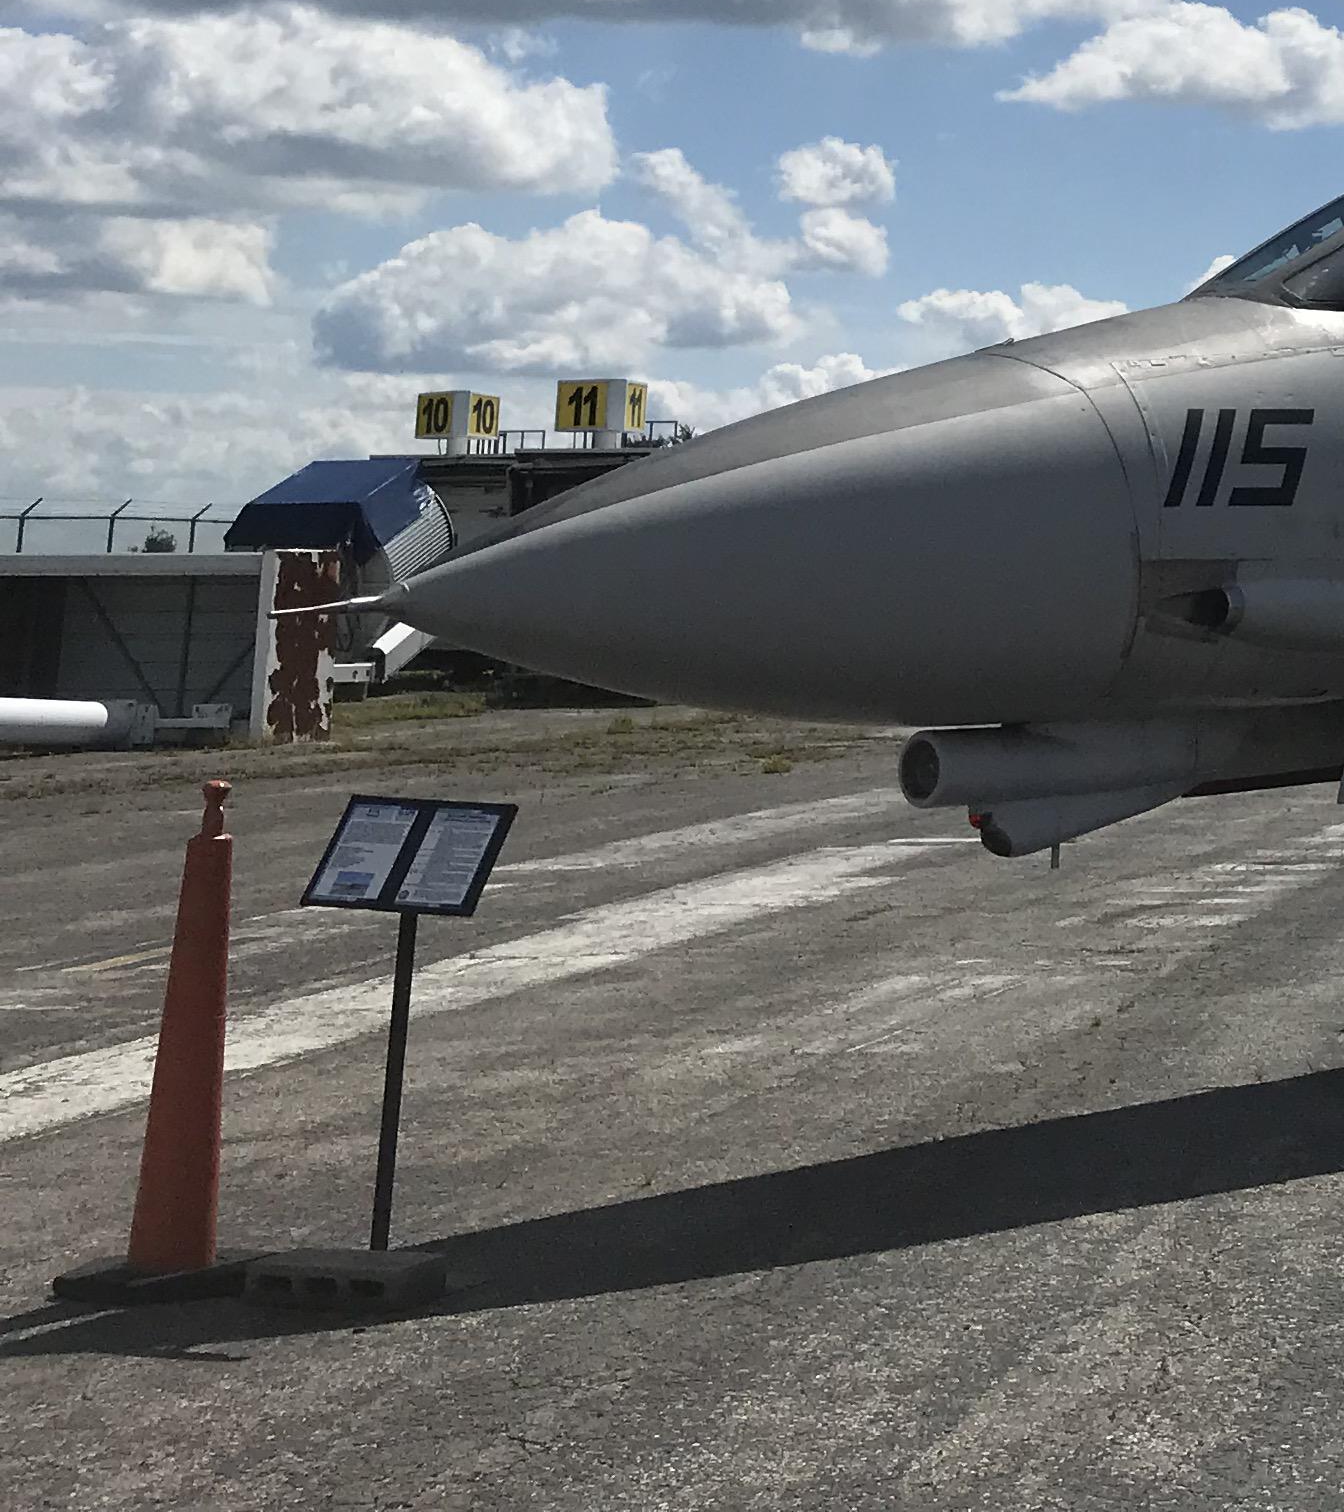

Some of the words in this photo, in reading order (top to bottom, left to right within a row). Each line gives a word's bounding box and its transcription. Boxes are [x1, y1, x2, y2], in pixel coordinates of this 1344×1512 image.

[422, 396, 449, 434] 10
[472, 397, 495, 435] 10
[567, 385, 599, 426] 11
[629, 387, 642, 426] 11
[1163, 408, 1315, 508] 115
